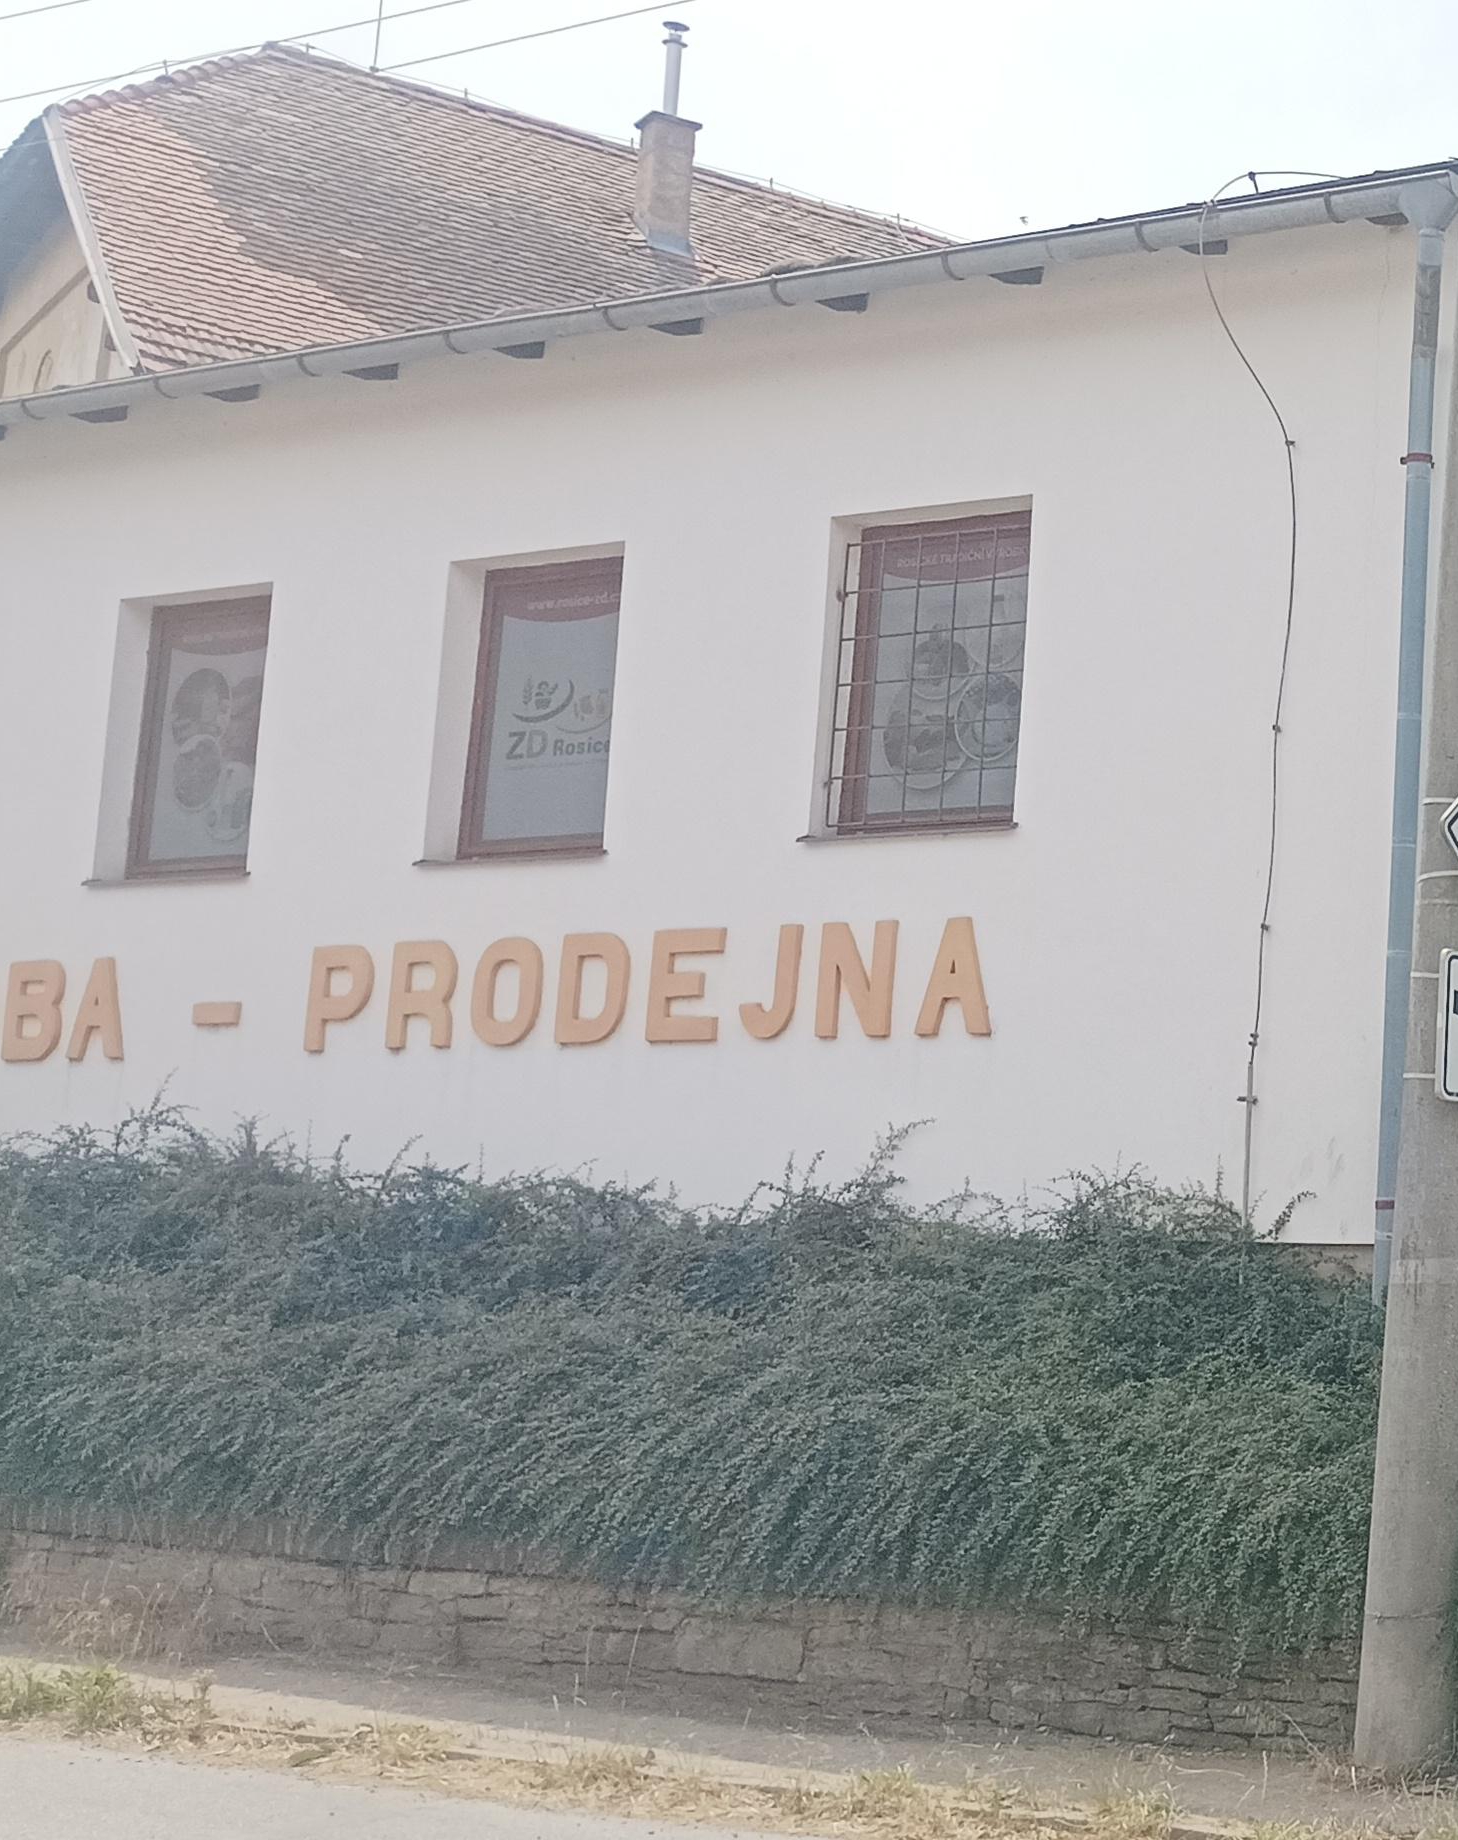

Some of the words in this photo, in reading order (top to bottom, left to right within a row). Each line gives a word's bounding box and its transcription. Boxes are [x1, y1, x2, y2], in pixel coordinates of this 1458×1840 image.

[506, 729, 548, 760] ZD
[1, 956, 124, 1062] BA
[303, 916, 992, 1054] PRODEJNA
